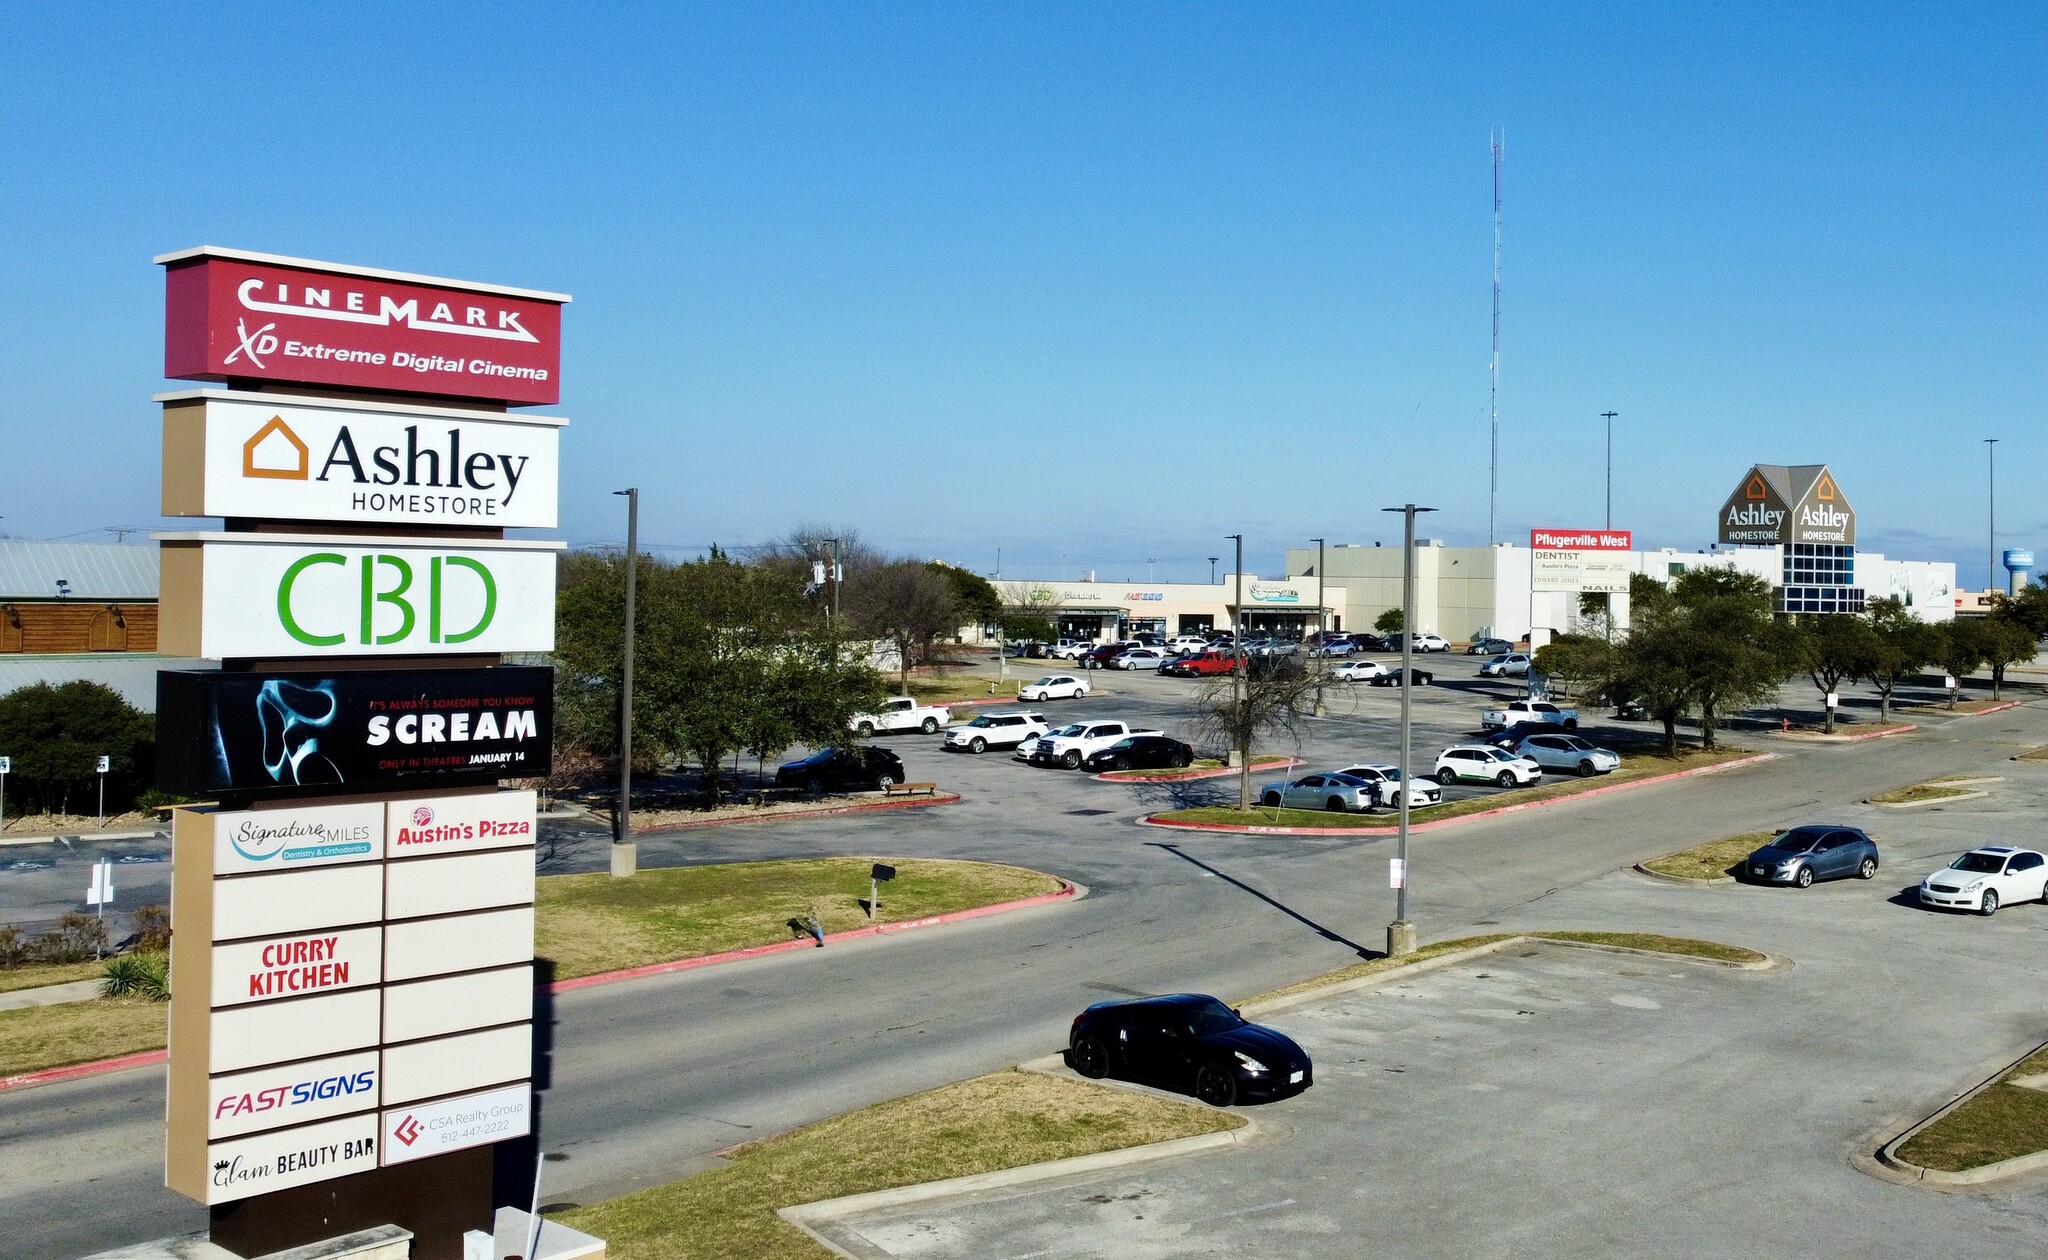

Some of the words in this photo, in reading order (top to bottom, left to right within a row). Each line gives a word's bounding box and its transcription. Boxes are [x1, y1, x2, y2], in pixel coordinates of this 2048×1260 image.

[238, 279, 540, 343] CINEMARK
[223, 317, 278, 369] XD
[284, 341, 386, 366] Extreme
[392, 352, 463, 374] Digital
[468, 359, 548, 381] Cinema
[316, 426, 529, 508] Ashley
[352, 492, 497, 516] HOMESTORE
[1726, 503, 1786, 532] Ashley
[1800, 504, 1850, 533] Ashley
[1535, 533, 1598, 548] Pflugerville
[1600, 535, 1628, 547] West
[1729, 530, 1780, 541] HOMESTORE
[1802, 531, 1846, 542] HOMESTORE
[1535, 551, 1580, 560] DENTIST
[277, 552, 497, 647] CBD
[370, 701, 386, 710] IT'S
[389, 699, 430, 710] ALWAYS
[432, 698, 480, 709] SOMEONE
[483, 698, 502, 707] YOU
[504, 696, 534, 706] KNOW
[366, 710, 537, 746] SCREAM
[379, 759, 405, 770] ONLY
[409, 758, 420, 768] IN
[423, 756, 467, 767] THEATRES
[468, 752, 512, 765] JANUARY
[514, 751, 525, 762] 14
[237, 820, 326, 846] Signature
[317, 826, 370, 844] SMILES
[397, 821, 474, 846] Austin's
[479, 819, 530, 839] Pizza
[283, 848, 315, 860] Dentistry
[316, 848, 323, 857] &
[323, 843, 368, 856] Orthodontics
[261, 937, 339, 968] CURRY
[249, 962, 349, 997] KITCHEN
[214, 1070, 375, 1120] FASTSIGNS
[429, 1116, 454, 1131] CSA
[455, 1111, 489, 1128] Realty
[490, 1102, 524, 1119] Group
[441, 1119, 510, 1144] 512-447-2222
[213, 1154, 274, 1187] Glam
[277, 1144, 339, 1174] BEAUTY
[344, 1138, 374, 1160] BAR
